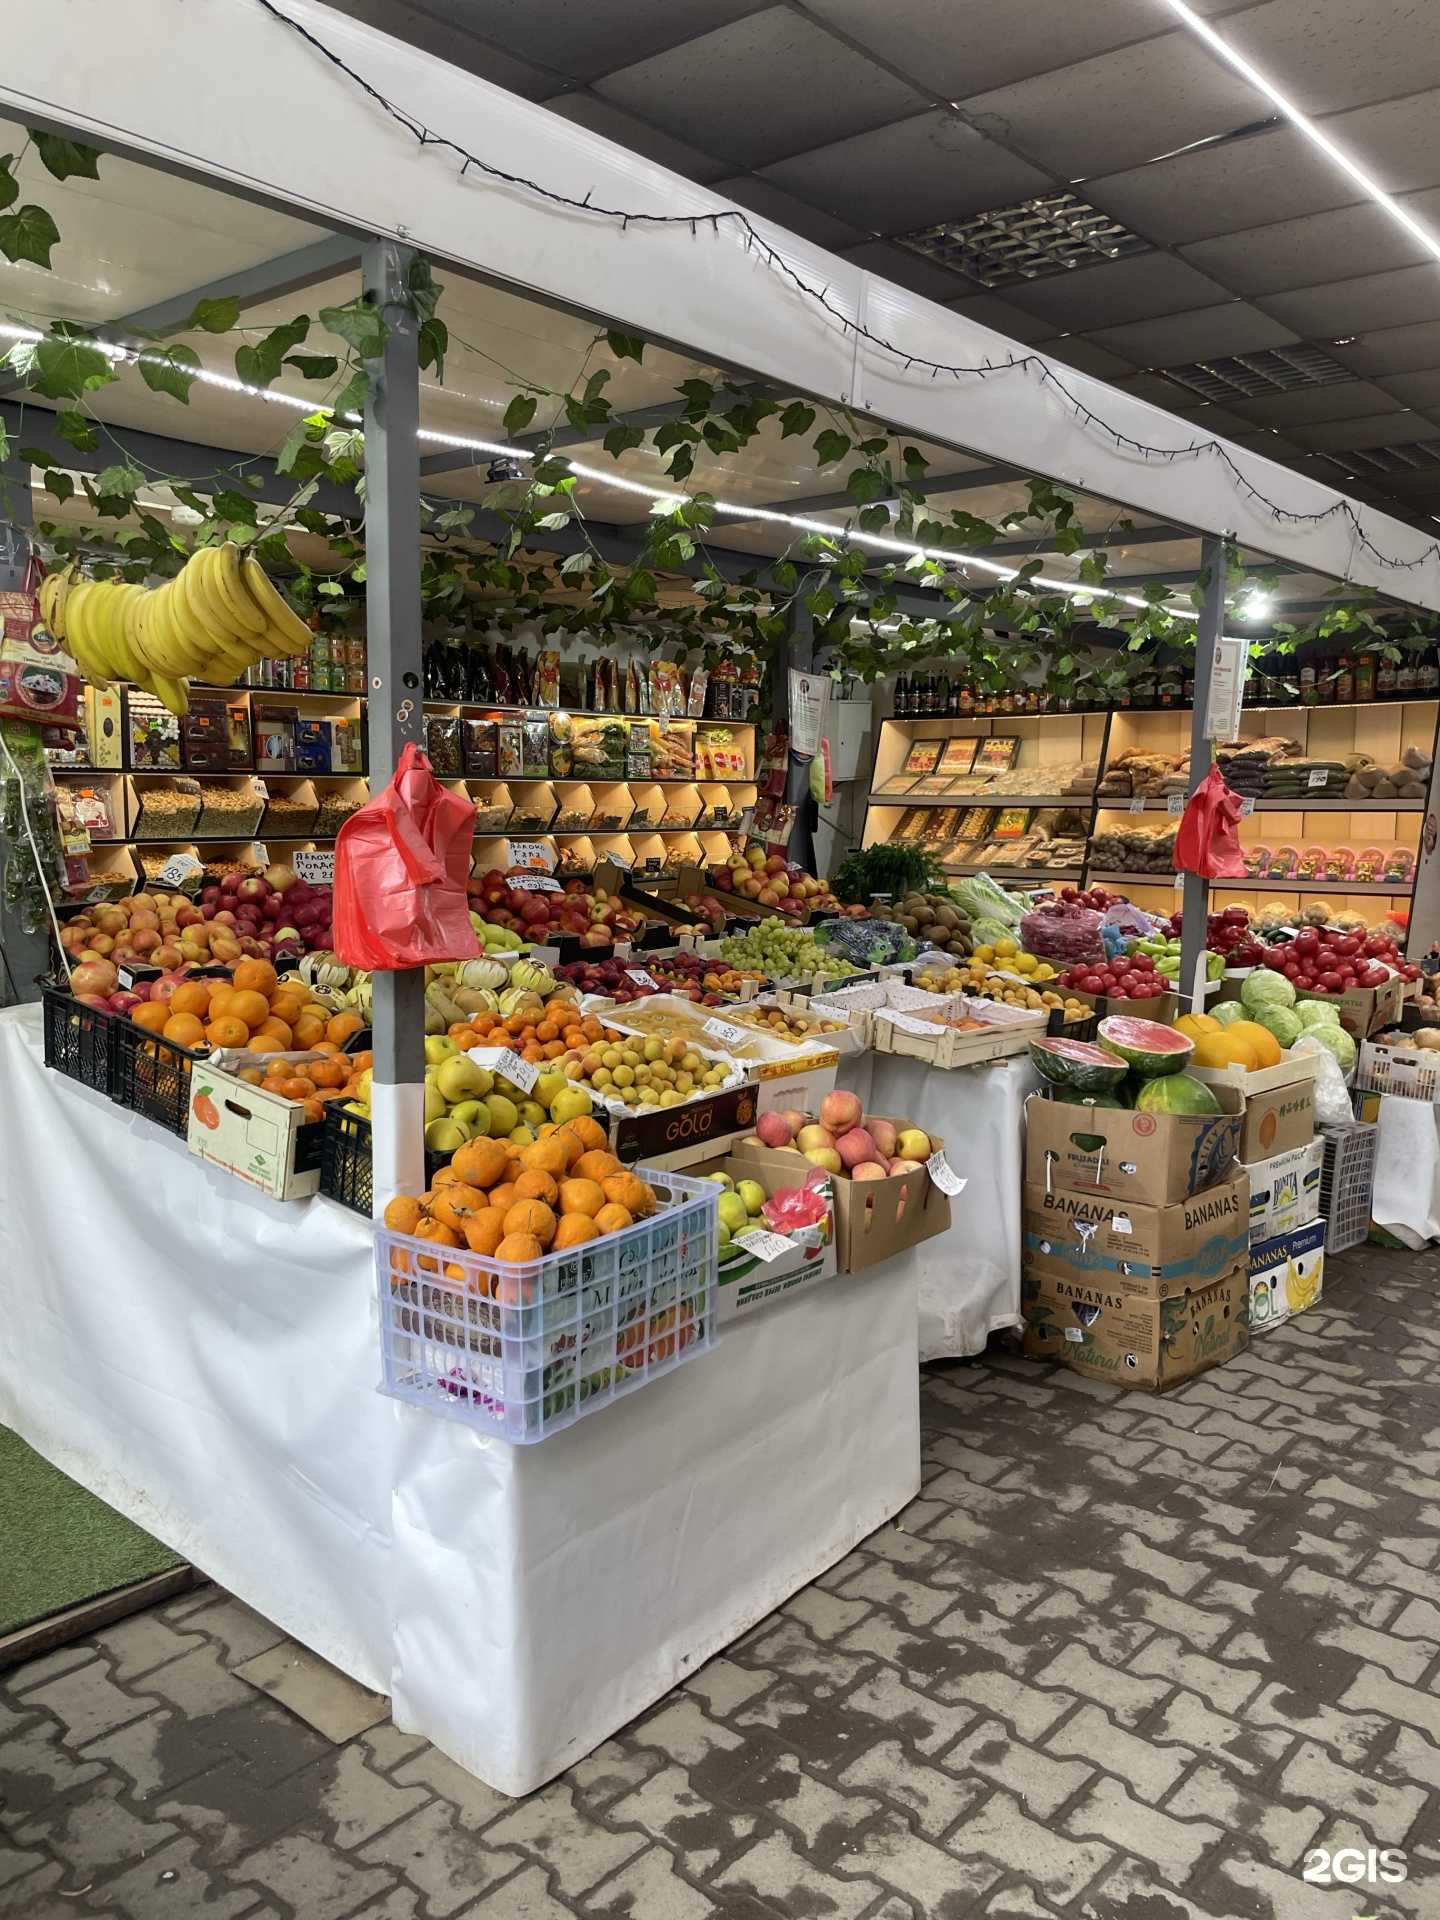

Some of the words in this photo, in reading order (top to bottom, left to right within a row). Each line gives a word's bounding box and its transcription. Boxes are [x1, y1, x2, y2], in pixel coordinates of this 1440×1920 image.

[1272, 1171, 1299, 1207] BONITA
[1184, 1194, 1240, 1231] BANANAS
[1249, 1244, 1288, 1270] ANANAS
[1056, 1281, 1123, 1309] BANANAS
[1061, 1341, 1122, 1371] Natural
